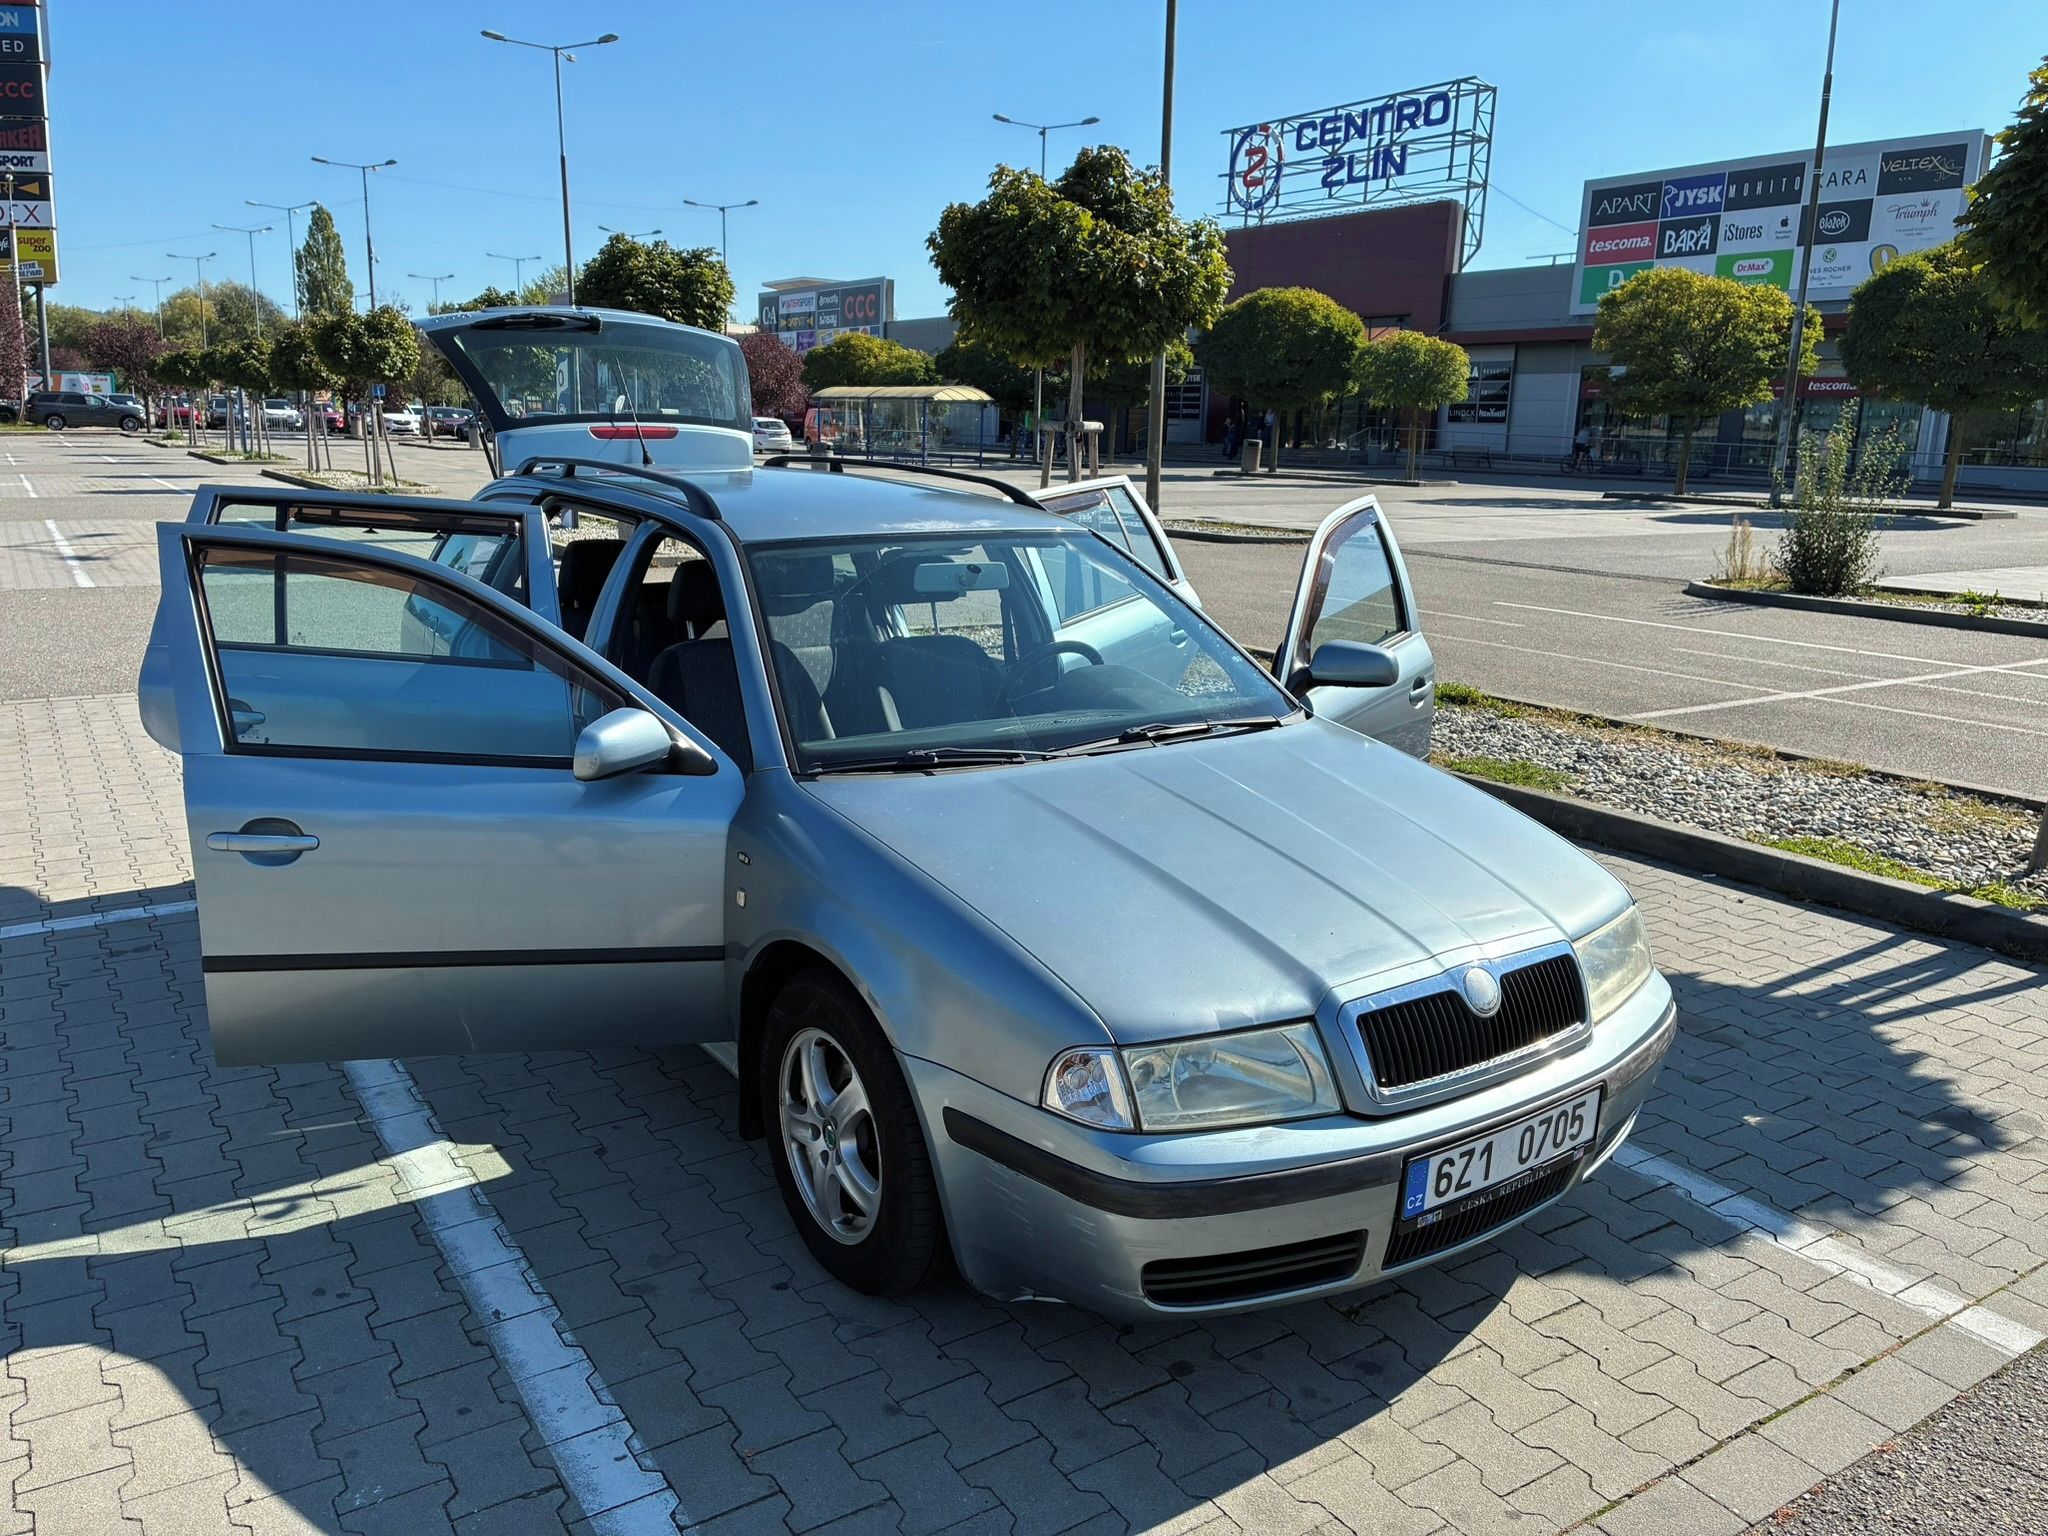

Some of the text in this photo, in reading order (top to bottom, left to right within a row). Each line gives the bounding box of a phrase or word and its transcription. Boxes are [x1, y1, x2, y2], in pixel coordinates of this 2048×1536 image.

[1296, 91, 1451, 151] CENTRO
[1881, 155, 1959, 175] VELTEX
[1728, 176, 1801, 198] MOHITO
[1820, 168, 1867, 189] ARA
[1596, 192, 1657, 216] APART
[1674, 185, 1723, 208] JYSK
[1887, 200, 1941, 223] Triumph
[18, 236, 47, 247] super
[1723, 222, 1763, 242] iStores
[844, 293, 876, 320] CCC
[1434, 1099, 1587, 1198] 6Z1 0705
[1406, 1193, 1424, 1210] CZ
